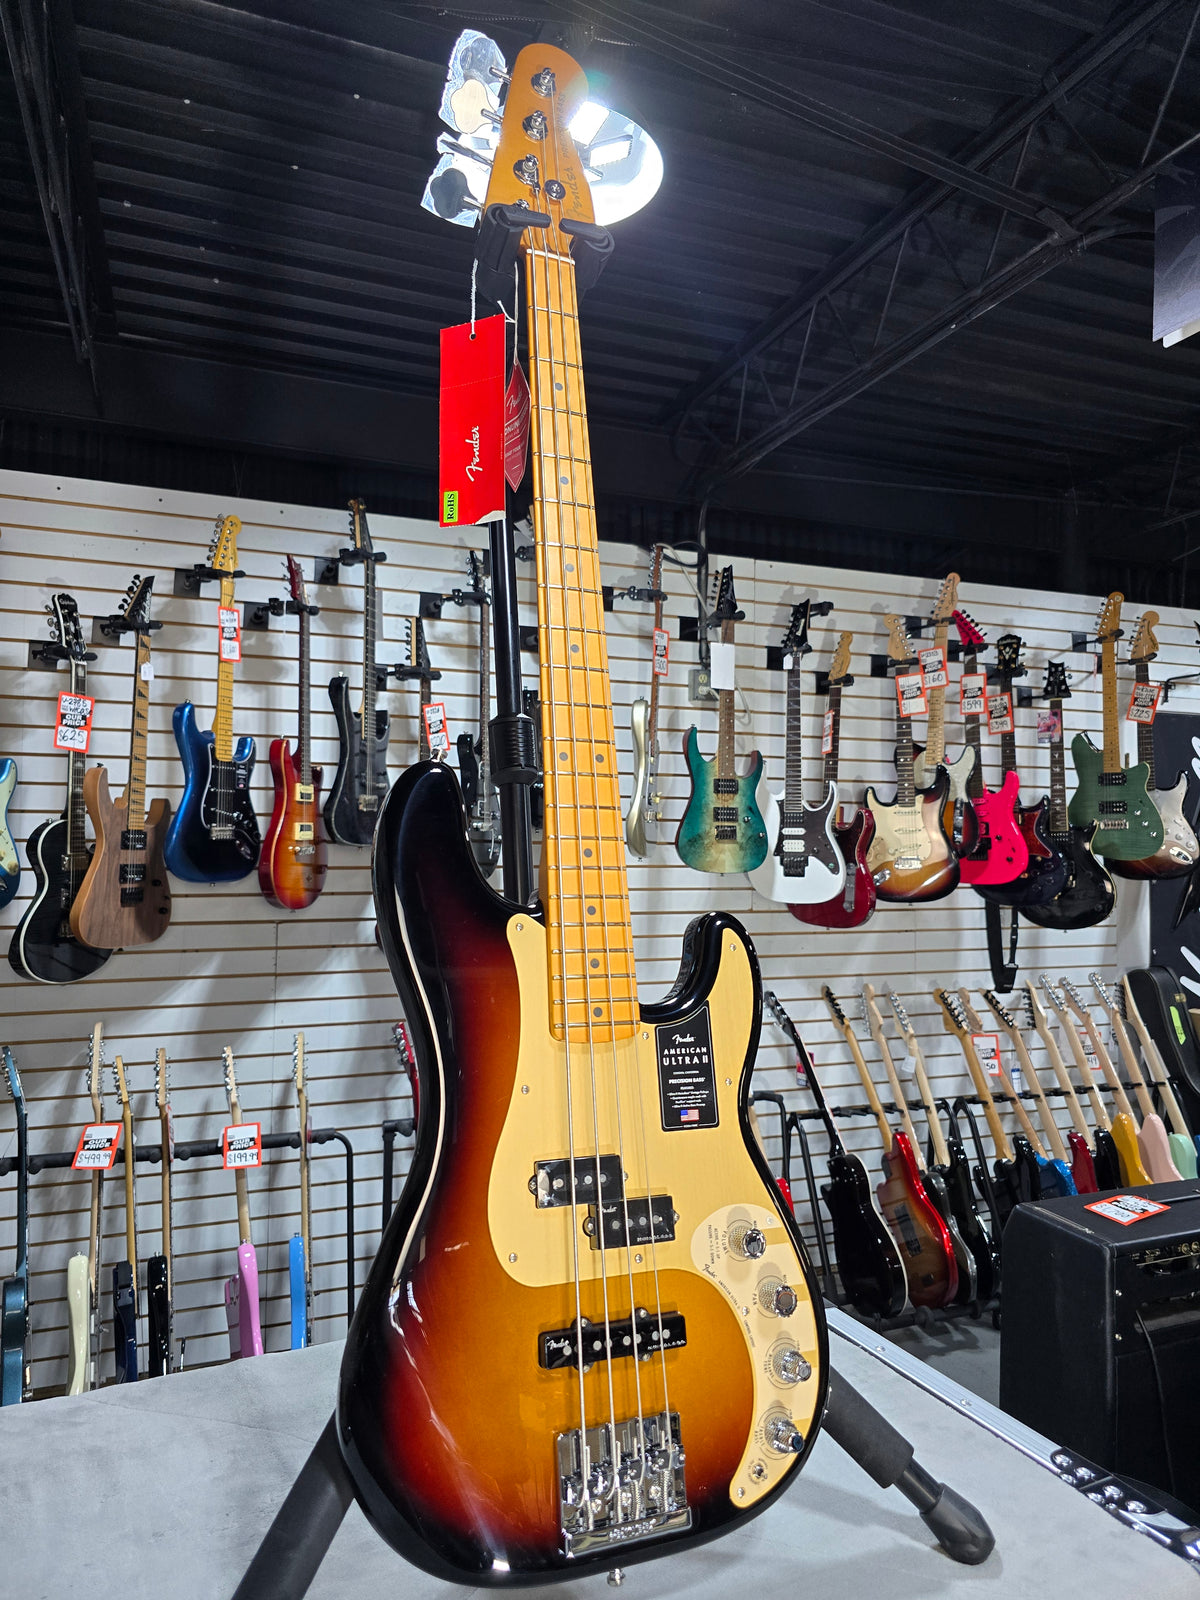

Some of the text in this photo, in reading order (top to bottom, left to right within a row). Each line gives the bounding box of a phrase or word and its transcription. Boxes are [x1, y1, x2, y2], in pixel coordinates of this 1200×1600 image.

[561, 166, 591, 219] Fender
[465, 425, 483, 482] Fender
[446, 493, 455, 520] RoHS
[962, 700, 982, 710] $599
[1130, 708, 1150, 719] $225
[58, 729, 84, 744] $625
[672, 1034, 695, 1044] Fender
[664, 1046, 708, 1055] AMERICAN
[662, 1054, 709, 1066] ULTRA II
[84, 1142, 111, 1150] PRICE
[230, 1140, 255, 1150] PRICE
[232, 1138, 250, 1146] OUR
[722, 1230, 730, 1255] VOLUME
[702, 1264, 718, 1278] Fender
[718, 1280, 731, 1296] AMERICAN
[546, 1338, 570, 1350] Fender
